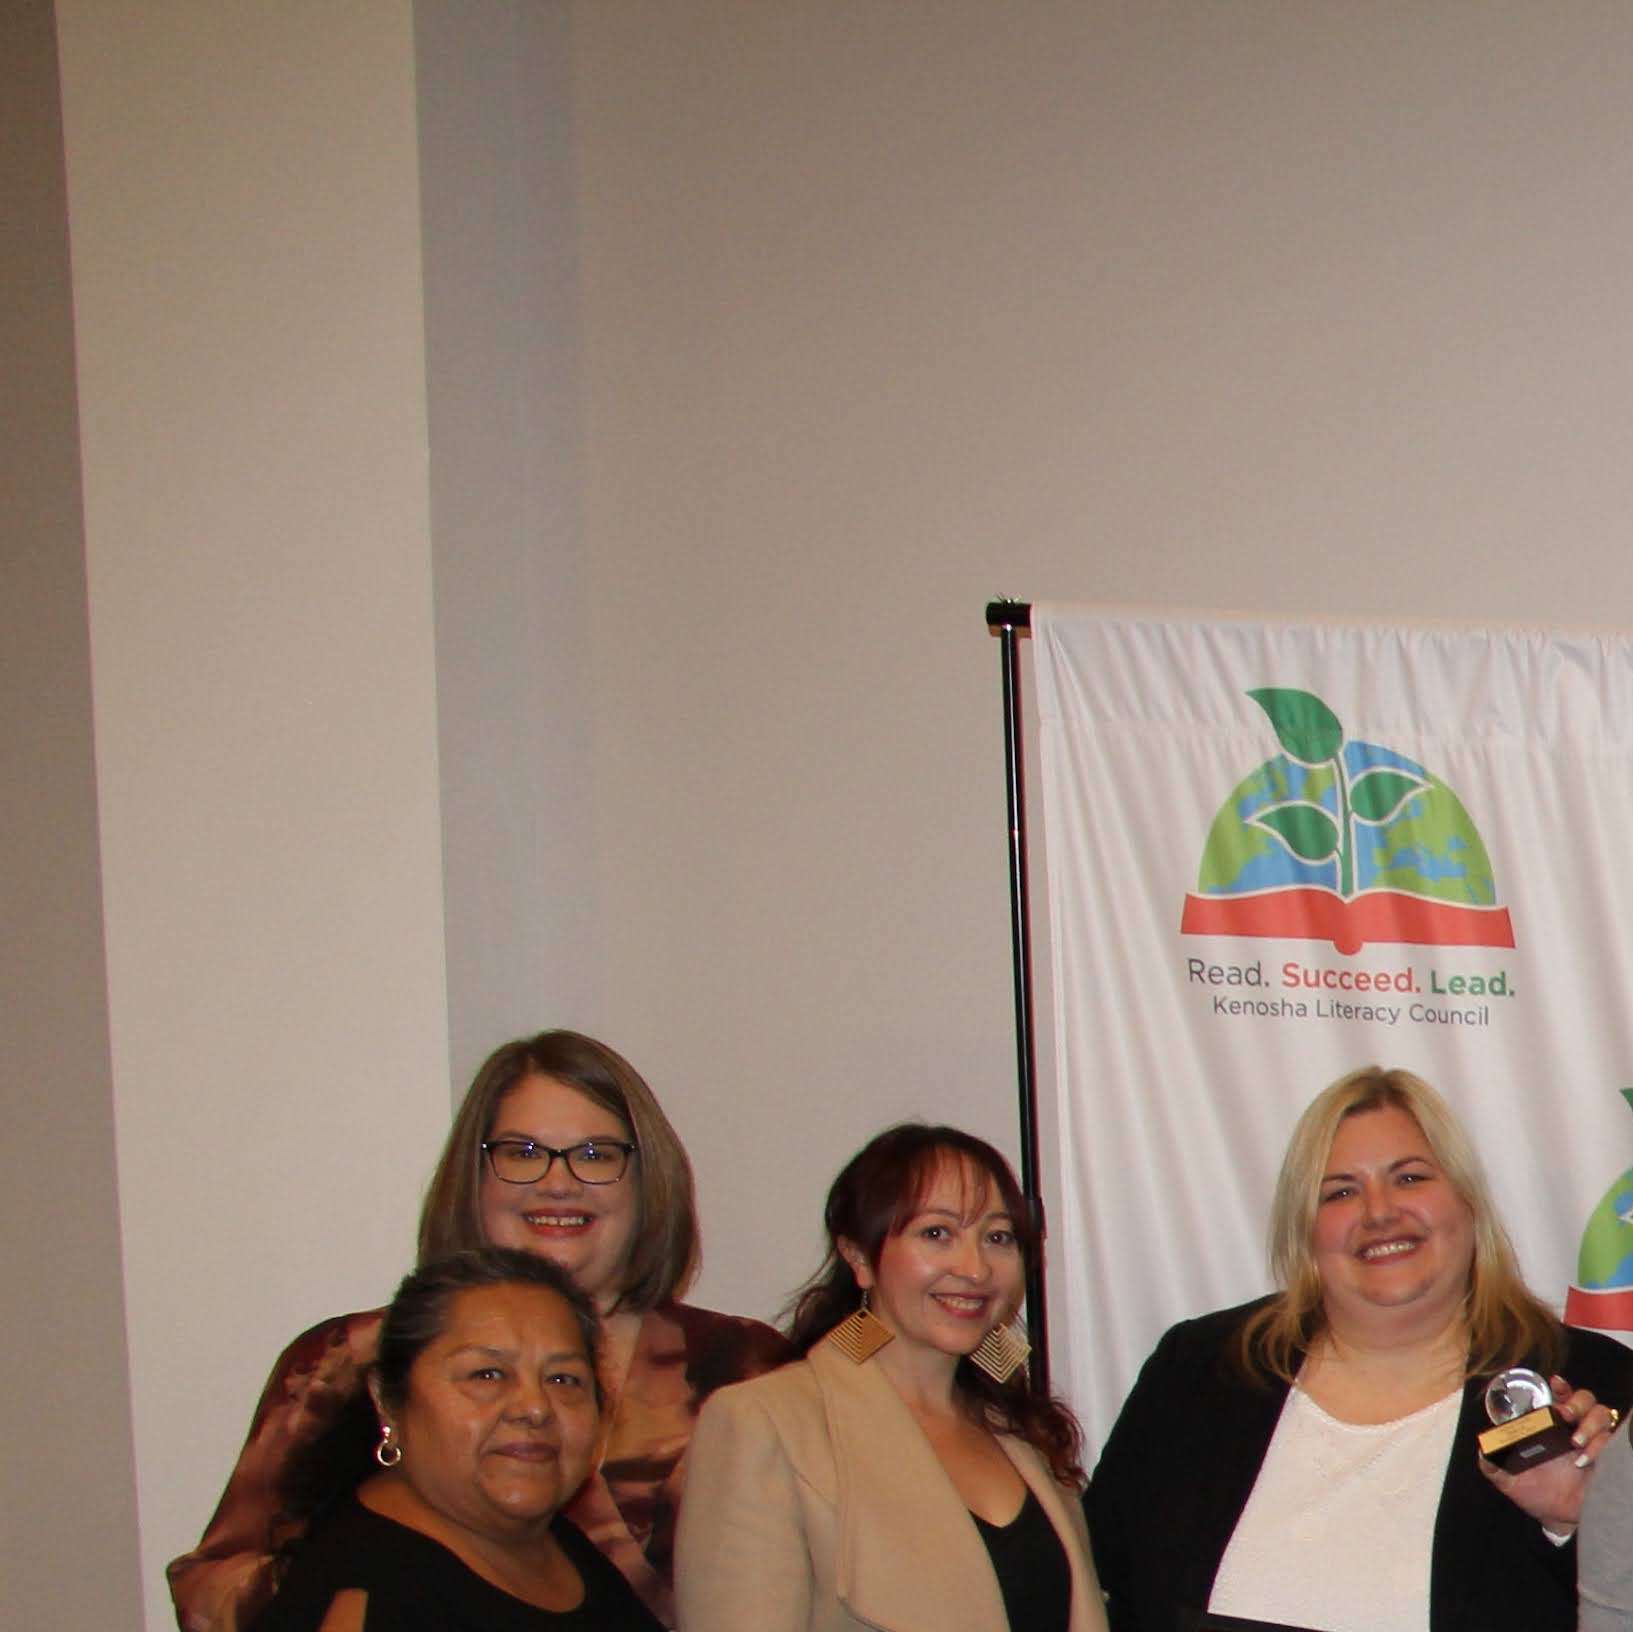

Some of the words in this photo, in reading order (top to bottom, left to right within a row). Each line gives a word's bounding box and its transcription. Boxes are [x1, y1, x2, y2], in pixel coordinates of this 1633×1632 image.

[1187, 958, 1271, 988] Read.
[1281, 962, 1422, 994] Succeed.
[1430, 969, 1516, 997] Lead.
[1213, 996, 1308, 1018] Kenosha
[1316, 1000, 1401, 1026] Literacy
[1408, 1003, 1490, 1026] Council
